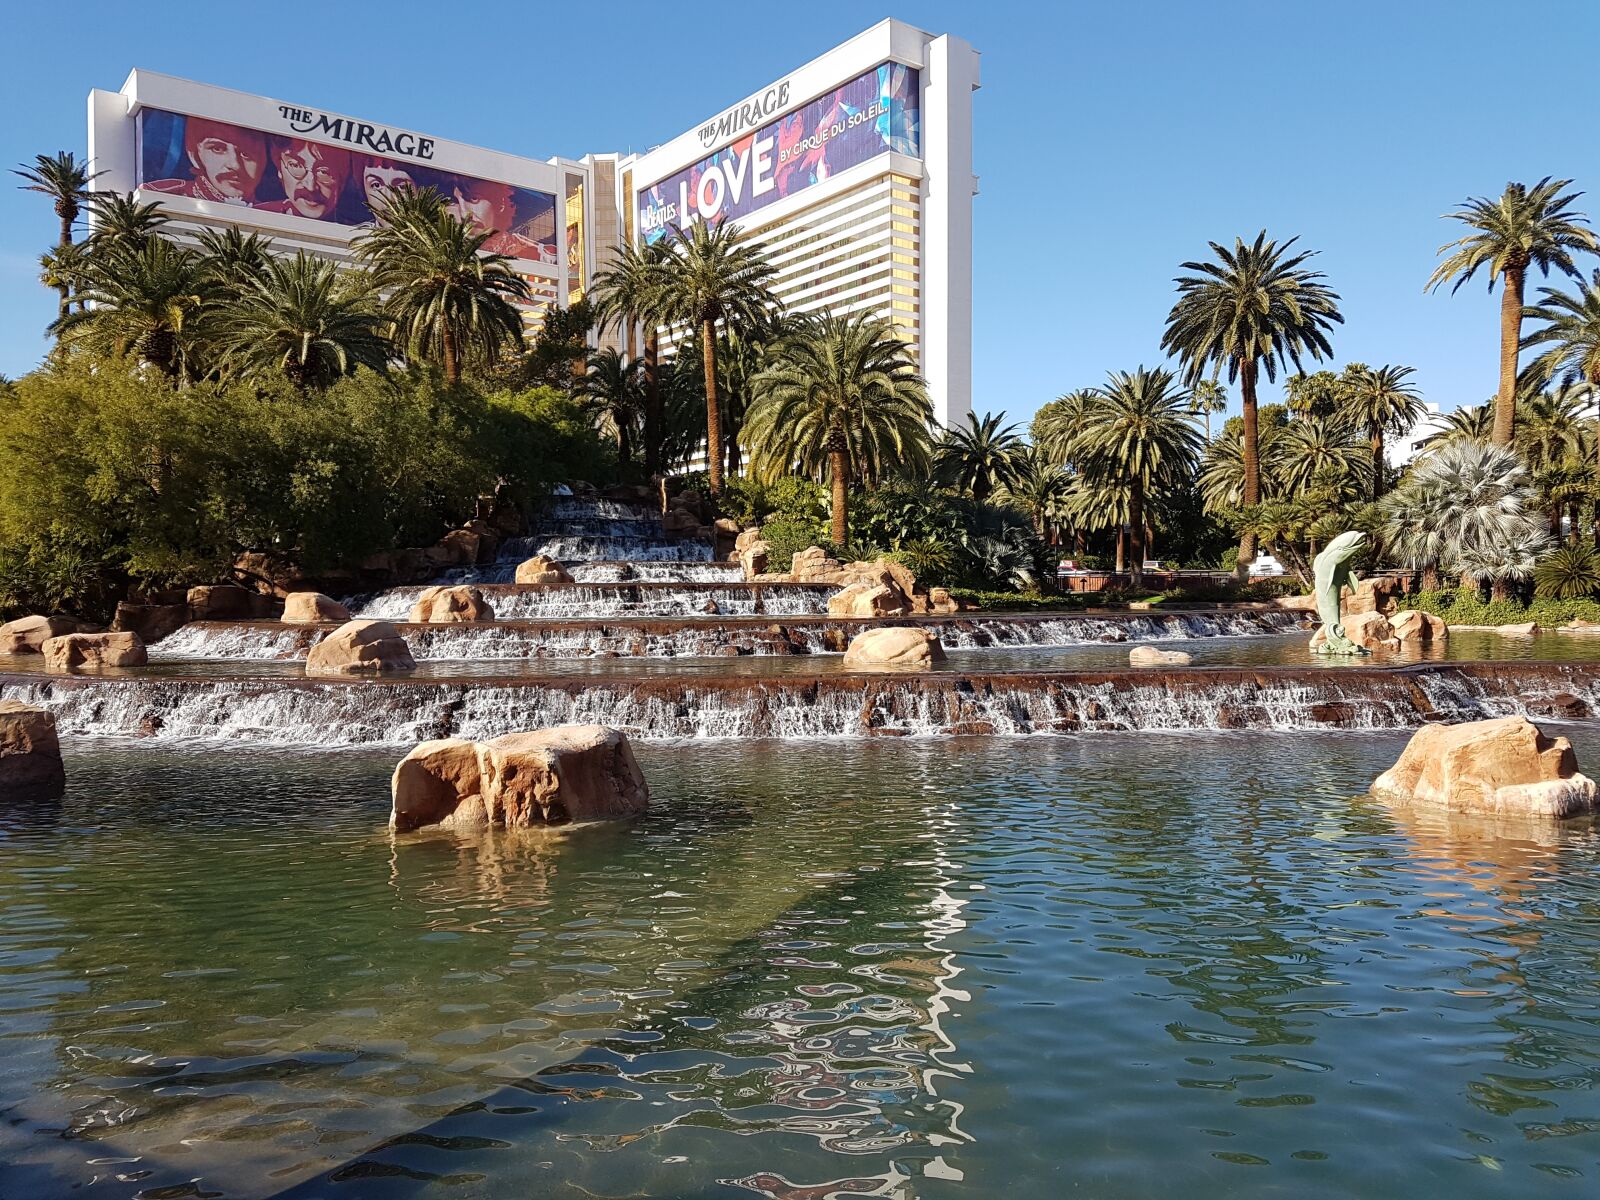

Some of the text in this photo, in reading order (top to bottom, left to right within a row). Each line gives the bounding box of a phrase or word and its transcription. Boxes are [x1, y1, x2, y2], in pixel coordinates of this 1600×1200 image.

[278, 105, 435, 160] THE MIRAGE
[698, 80, 790, 149] THE MIRAGE
[780, 147, 792, 162] BY
[793, 128, 829, 155] CIRQUE
[831, 120, 846, 137] DU
[679, 134, 775, 231] LOVE
